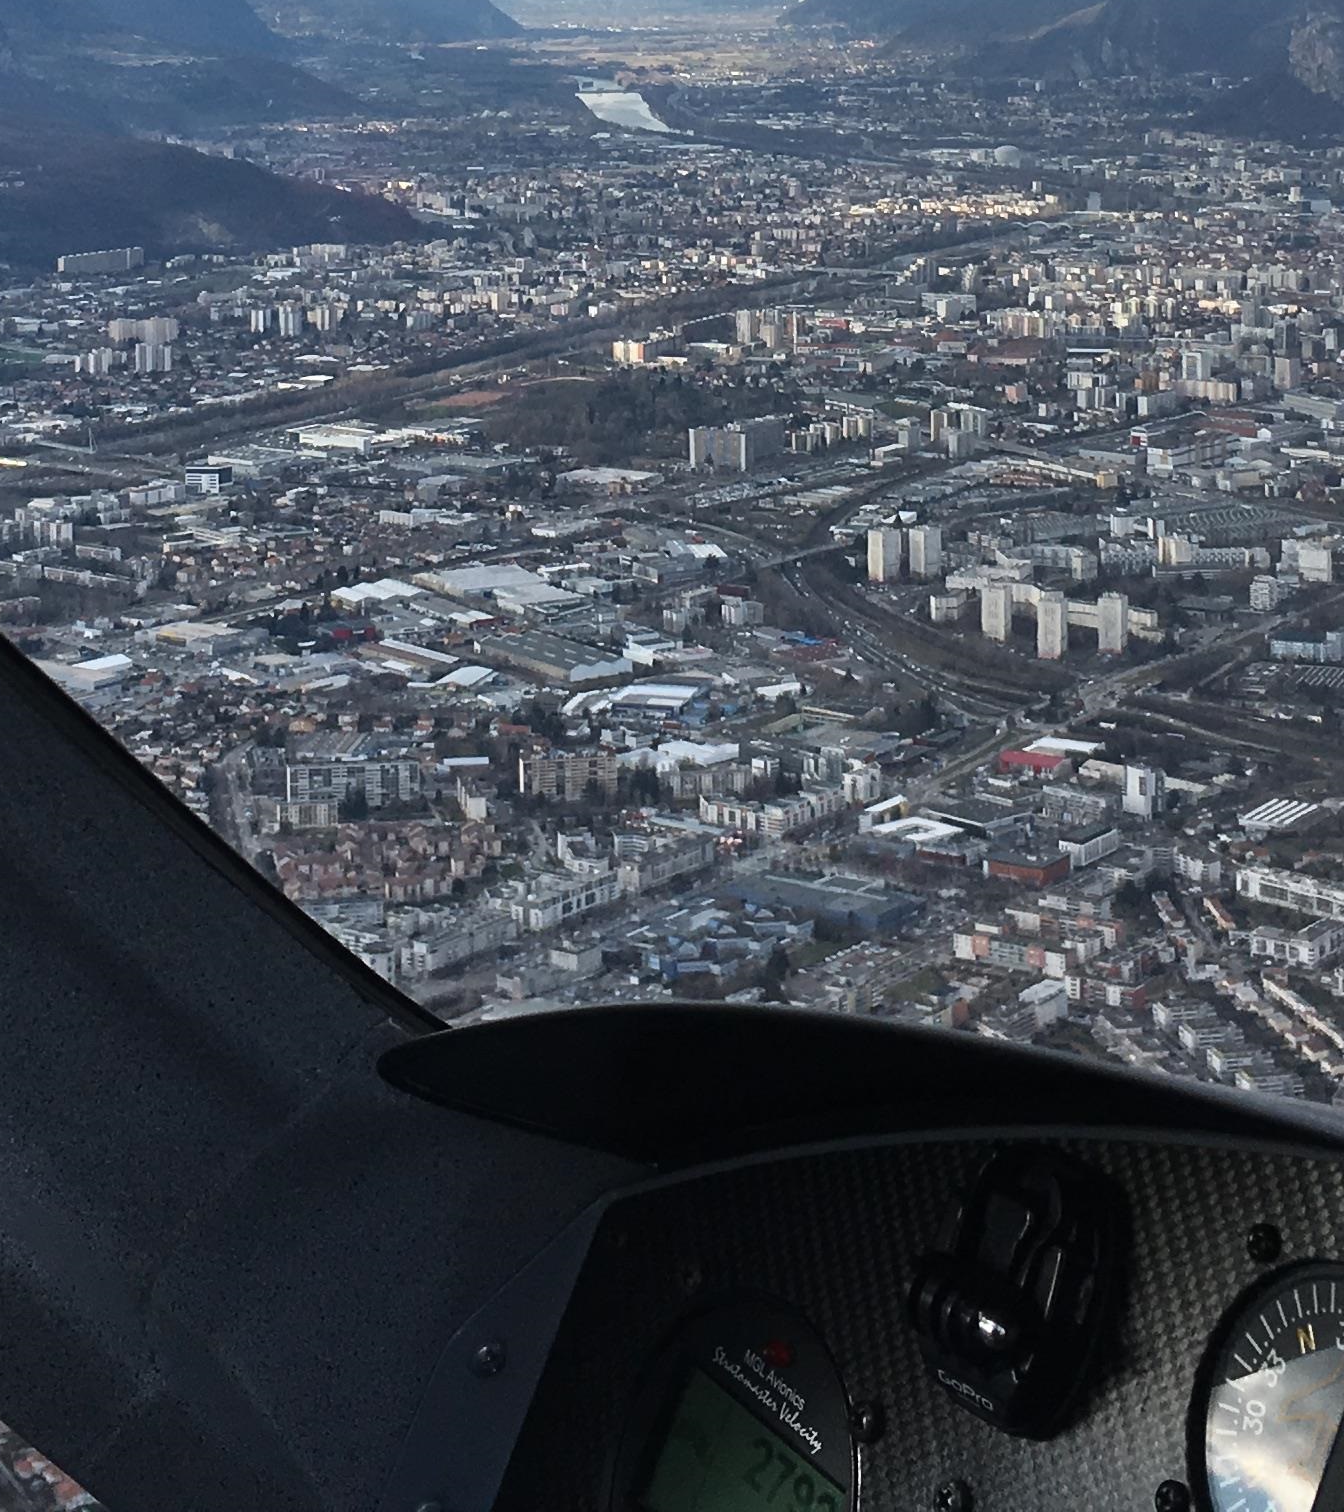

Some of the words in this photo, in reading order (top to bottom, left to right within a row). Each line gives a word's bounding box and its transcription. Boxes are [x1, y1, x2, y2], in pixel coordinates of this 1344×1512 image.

[712, 1346, 777, 1412] Stratomaster
[779, 1401, 823, 1455] Velocity
[743, 1349, 765, 1378] MGL
[766, 1370, 805, 1411] Avionics
[937, 1369, 993, 1411] GoPro
[1242, 1399, 1265, 1435] 30
[1260, 1348, 1286, 1387] 33
[1297, 1323, 1316, 1354] N
